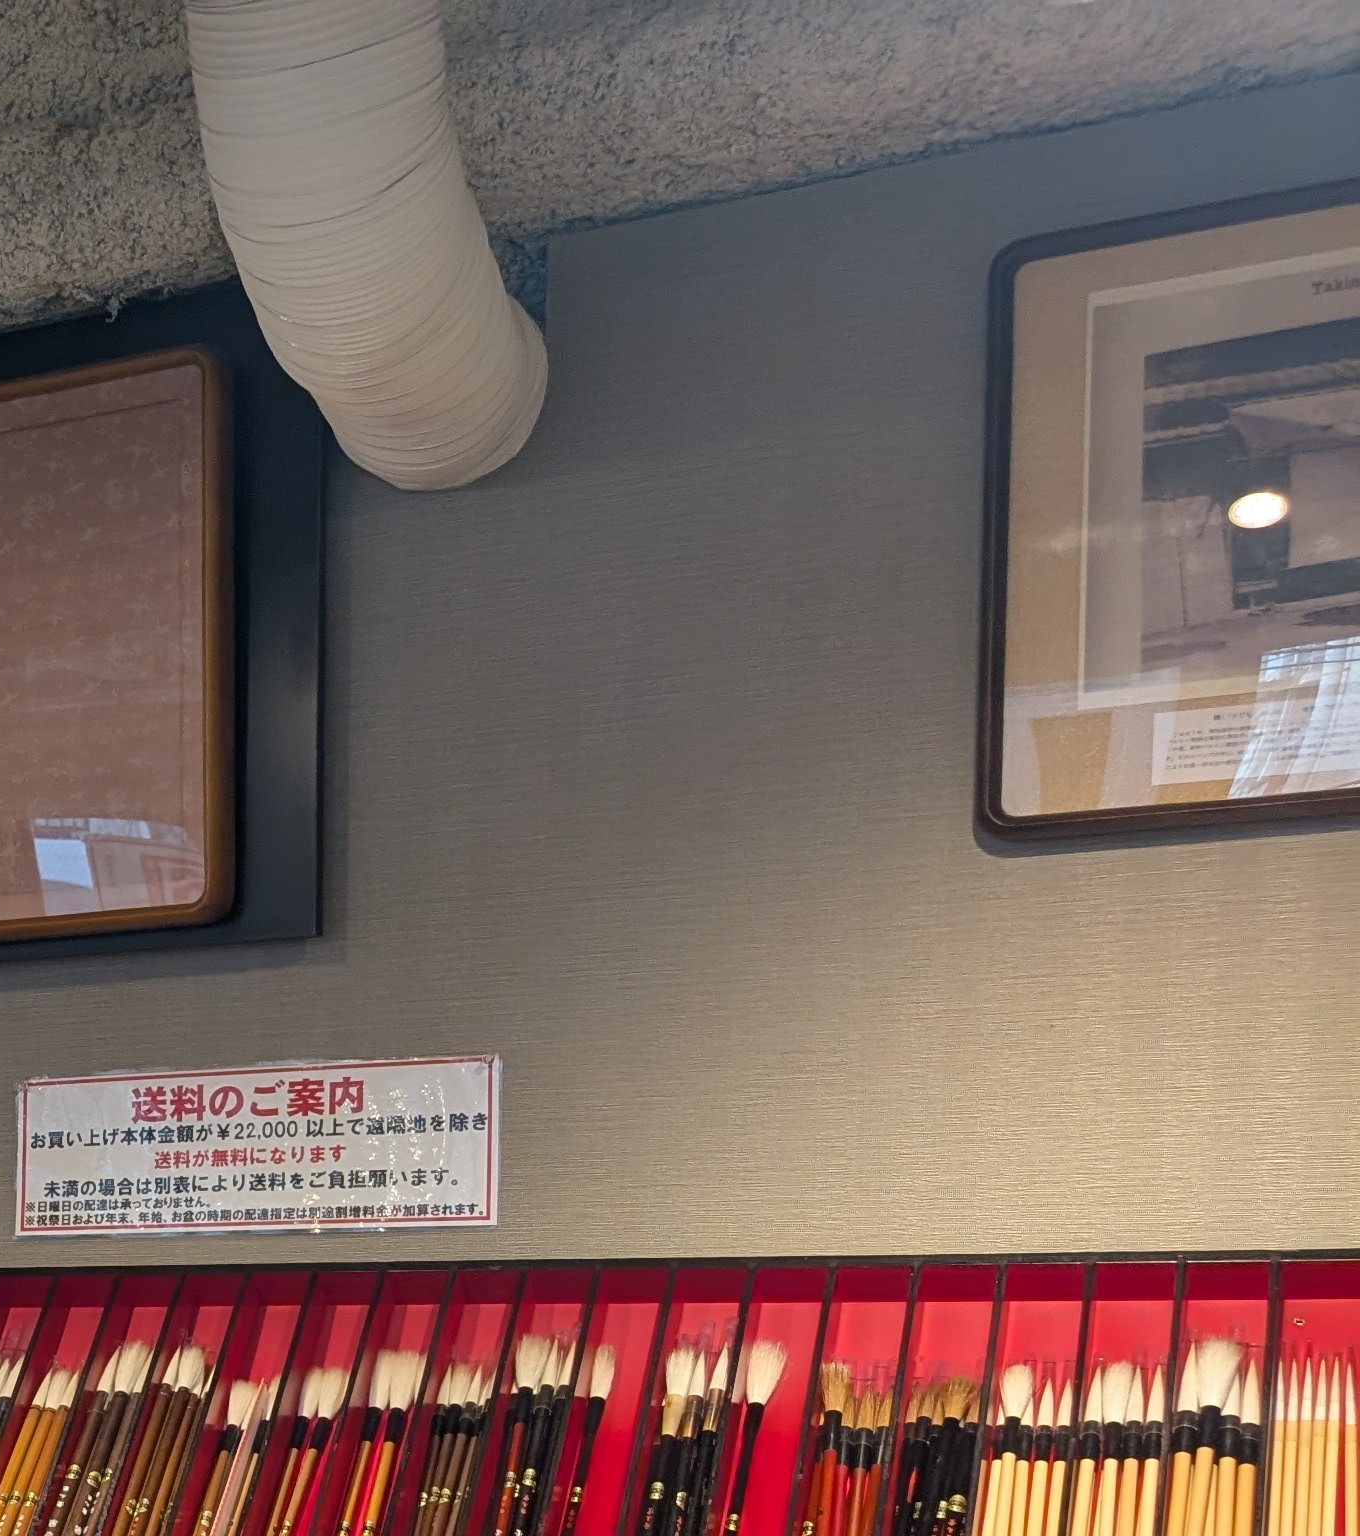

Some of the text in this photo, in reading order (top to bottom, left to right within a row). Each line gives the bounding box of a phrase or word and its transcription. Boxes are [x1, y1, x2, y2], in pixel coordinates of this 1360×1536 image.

[130, 1077, 365, 1124] 送料のご案内
[154, 1145, 347, 1170] 送料が無料になります
[43, 1168, 461, 1198] 未満の場合は別表により送料をご負担願います。
